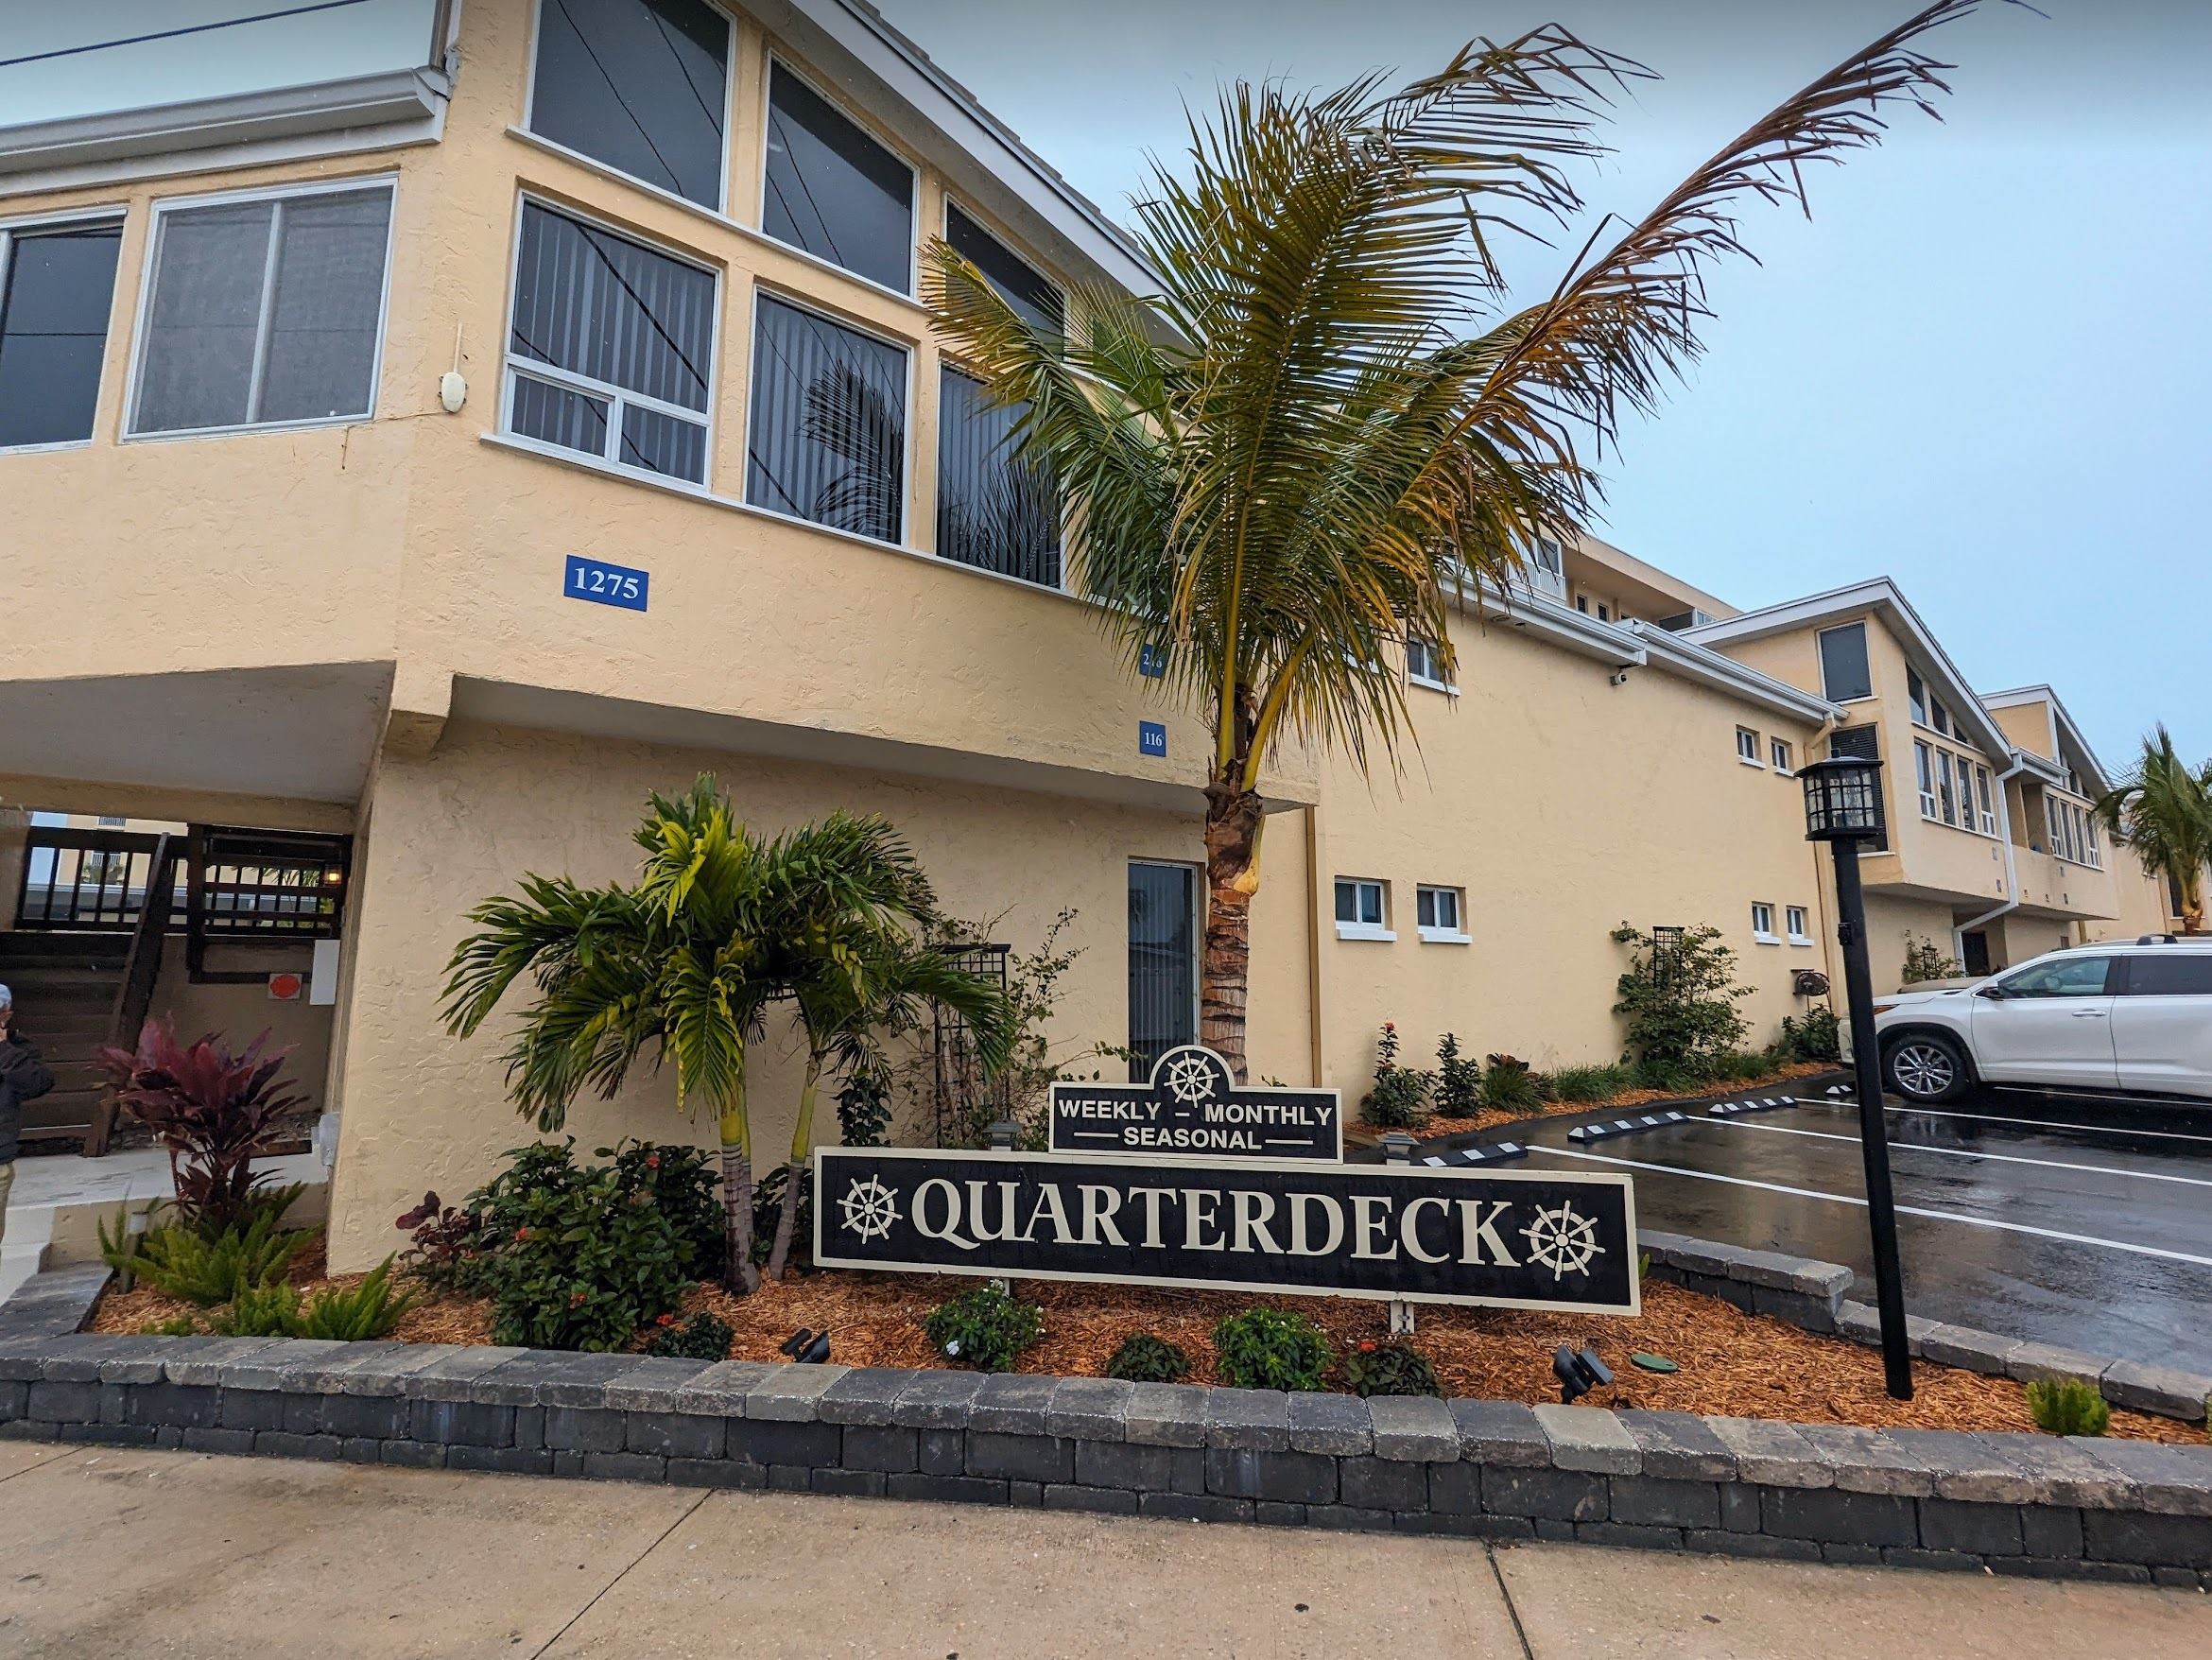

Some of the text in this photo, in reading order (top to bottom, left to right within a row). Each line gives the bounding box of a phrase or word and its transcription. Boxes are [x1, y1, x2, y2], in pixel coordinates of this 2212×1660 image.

[574, 567, 639, 599] 1275
[1145, 732, 1164, 747] 116
[1058, 1098, 1162, 1121] WEEKLY
[1204, 1103, 1333, 1127] MONTHLY
[1123, 1126, 1262, 1150] SEASONAL
[911, 1178, 1521, 1268] QUARTERDECK
